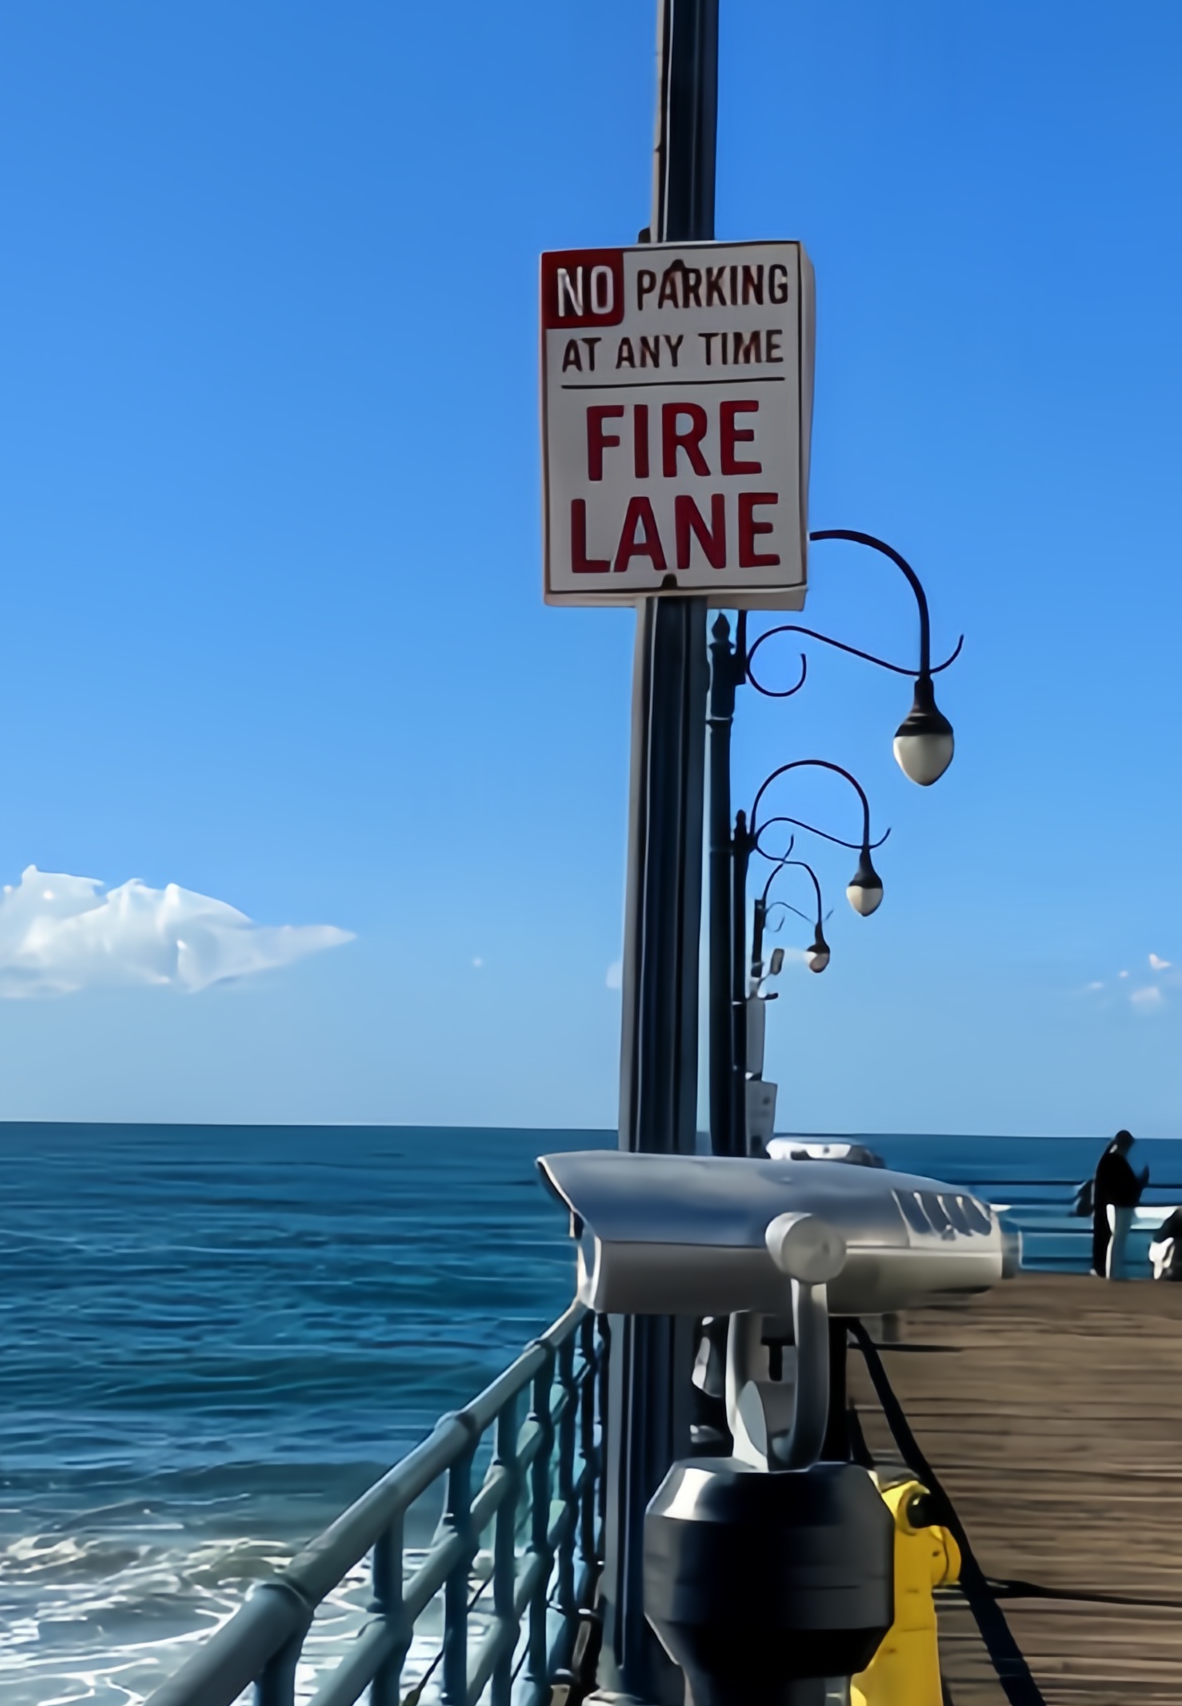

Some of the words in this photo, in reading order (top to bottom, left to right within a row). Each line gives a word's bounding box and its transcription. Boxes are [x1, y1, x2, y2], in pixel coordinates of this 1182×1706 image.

[557, 265, 614, 317] NO
[637, 264, 789, 311] PARKING
[561, 337, 602, 373] AT
[615, 334, 684, 369] ANY
[698, 329, 784, 366] TIME
[586, 400, 763, 482] FIRE
[570, 492, 781, 574] LANE
